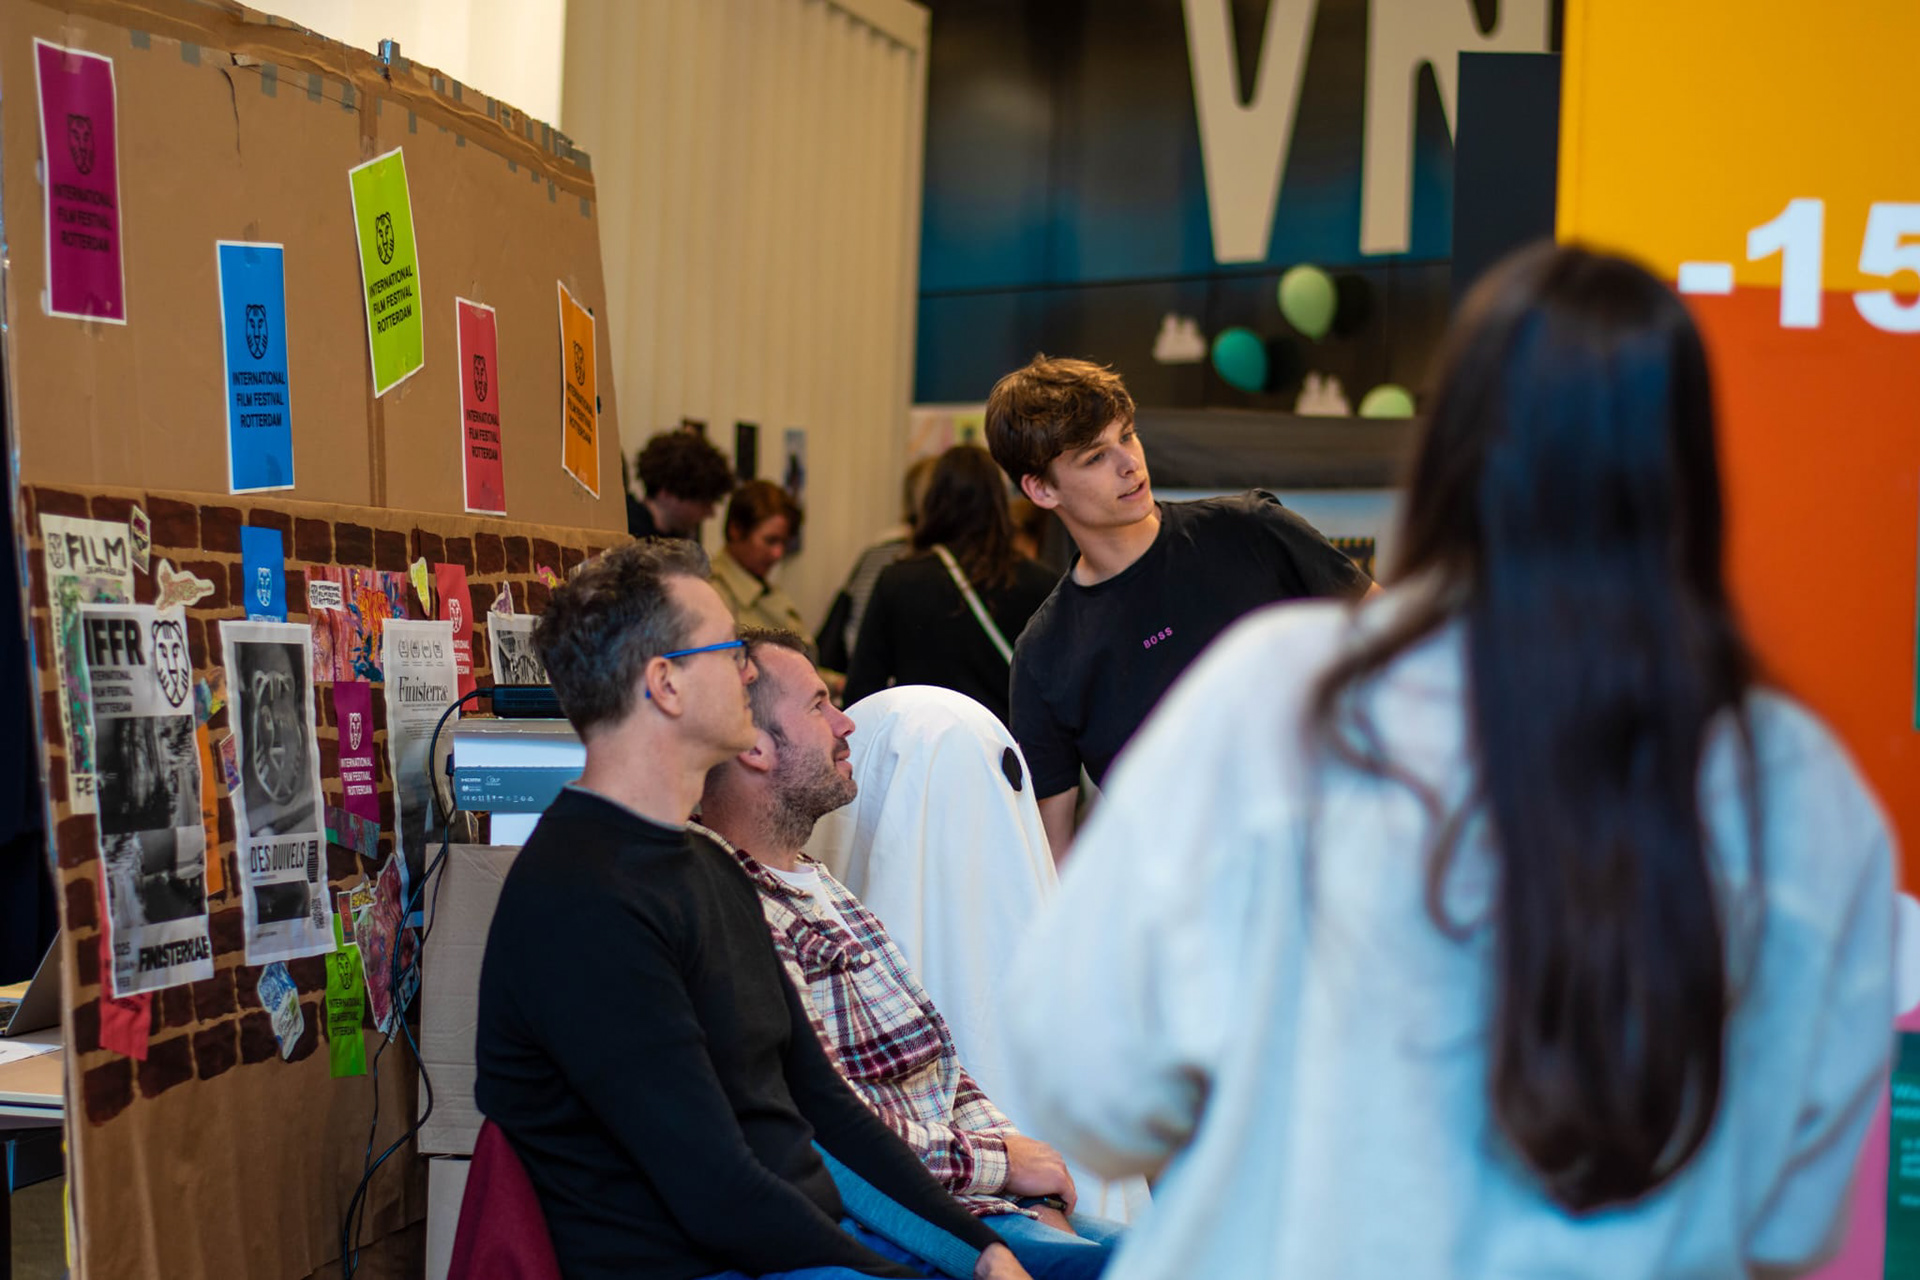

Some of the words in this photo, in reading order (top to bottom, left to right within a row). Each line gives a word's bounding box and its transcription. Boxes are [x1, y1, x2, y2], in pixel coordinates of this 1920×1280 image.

[369, 264, 413, 300] INTERNATIONAL
[373, 299, 386, 317] FILM
[386, 284, 413, 309] FESTIVAL
[377, 303, 413, 335] ROTTERDAM
[232, 371, 286, 386] INTERNATIONAL
[236, 392, 253, 407] FILM
[253, 391, 285, 406] FESTIVAL
[240, 412, 283, 428] ROTTERDAM
[466, 409, 500, 427] INTERNATIONAL
[471, 445, 498, 461] ROTTERDAM
[65, 532, 127, 571] FILM
[84, 618, 146, 667] IFFR
[1143, 626, 1173, 649] BOSS
[250, 844, 271, 873] DES
[273, 841, 306, 870] DUIVELS
